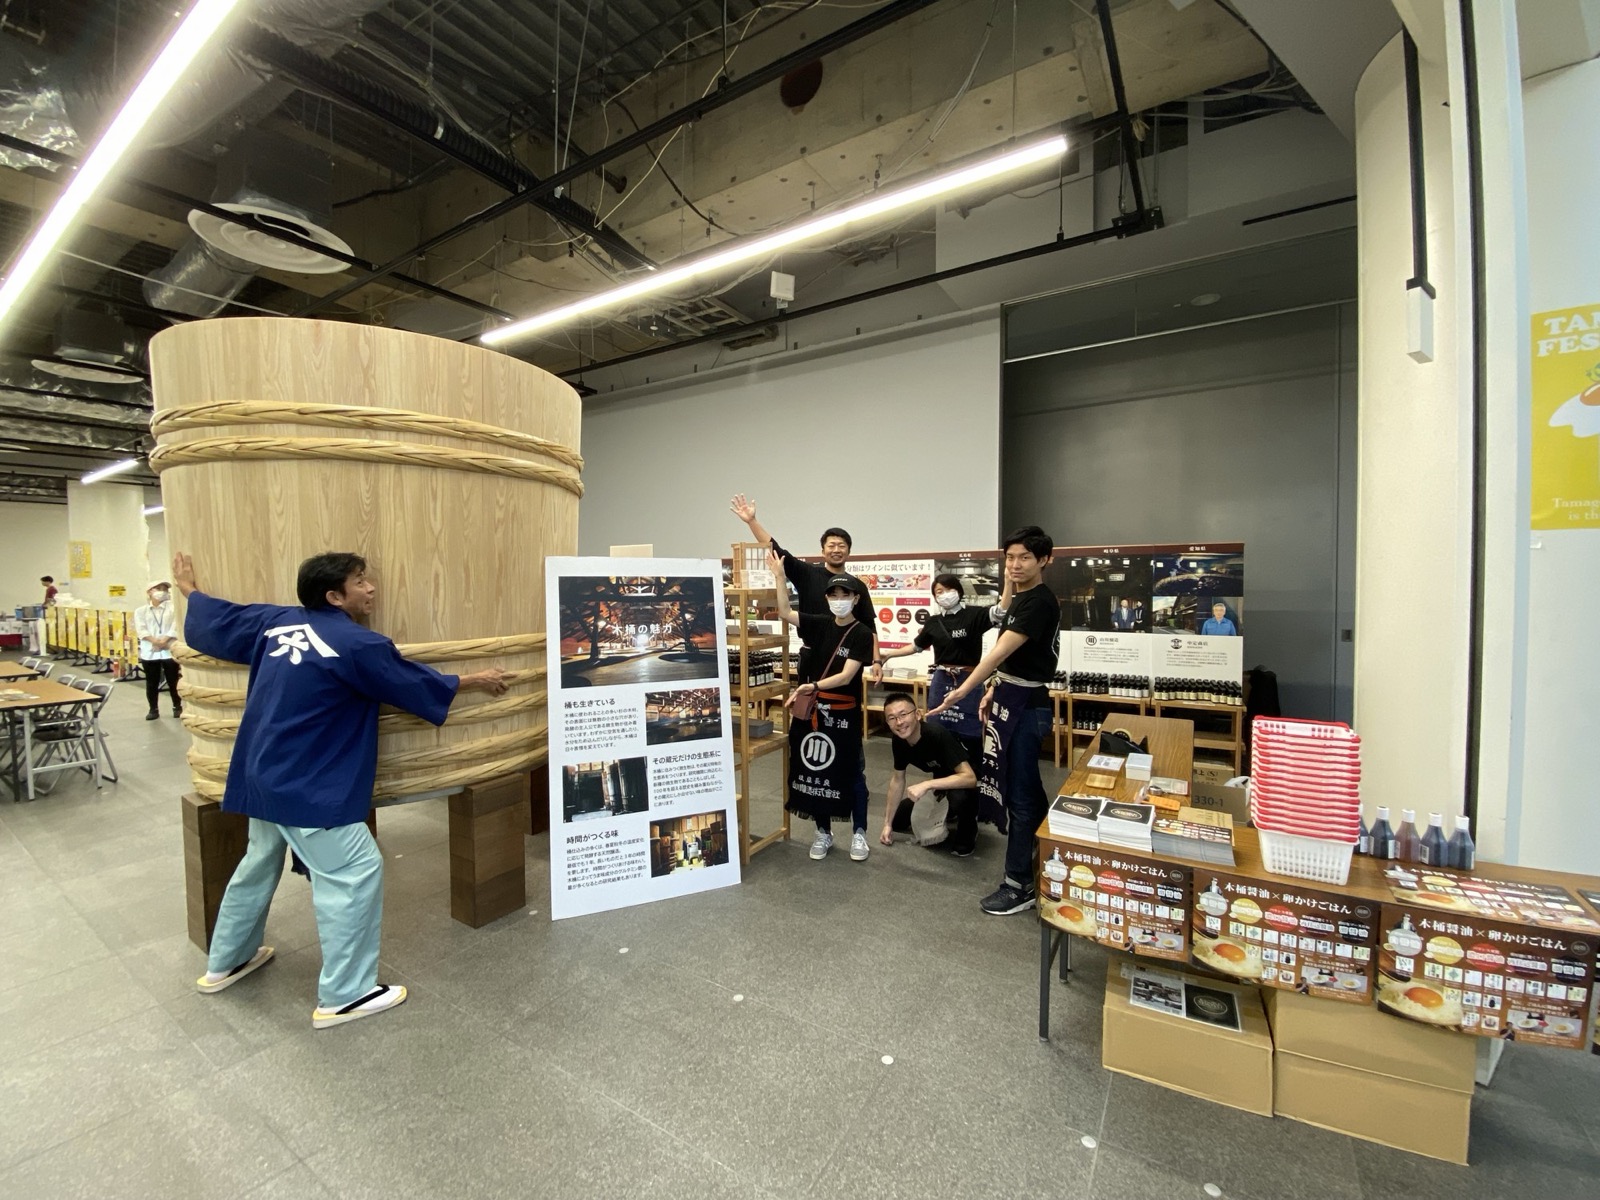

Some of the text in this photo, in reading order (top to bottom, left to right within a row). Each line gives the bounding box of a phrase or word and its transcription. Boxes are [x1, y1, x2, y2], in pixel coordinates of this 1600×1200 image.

[845, 563, 931, 572] 分類はワインに似ています！
[612, 624, 672, 635] 木桶の魅力
[564, 698, 616, 709] 桶も生きている
[653, 751, 721, 764] その蔵元だけの生態系に
[566, 830, 619, 844] 時間がつくる味
